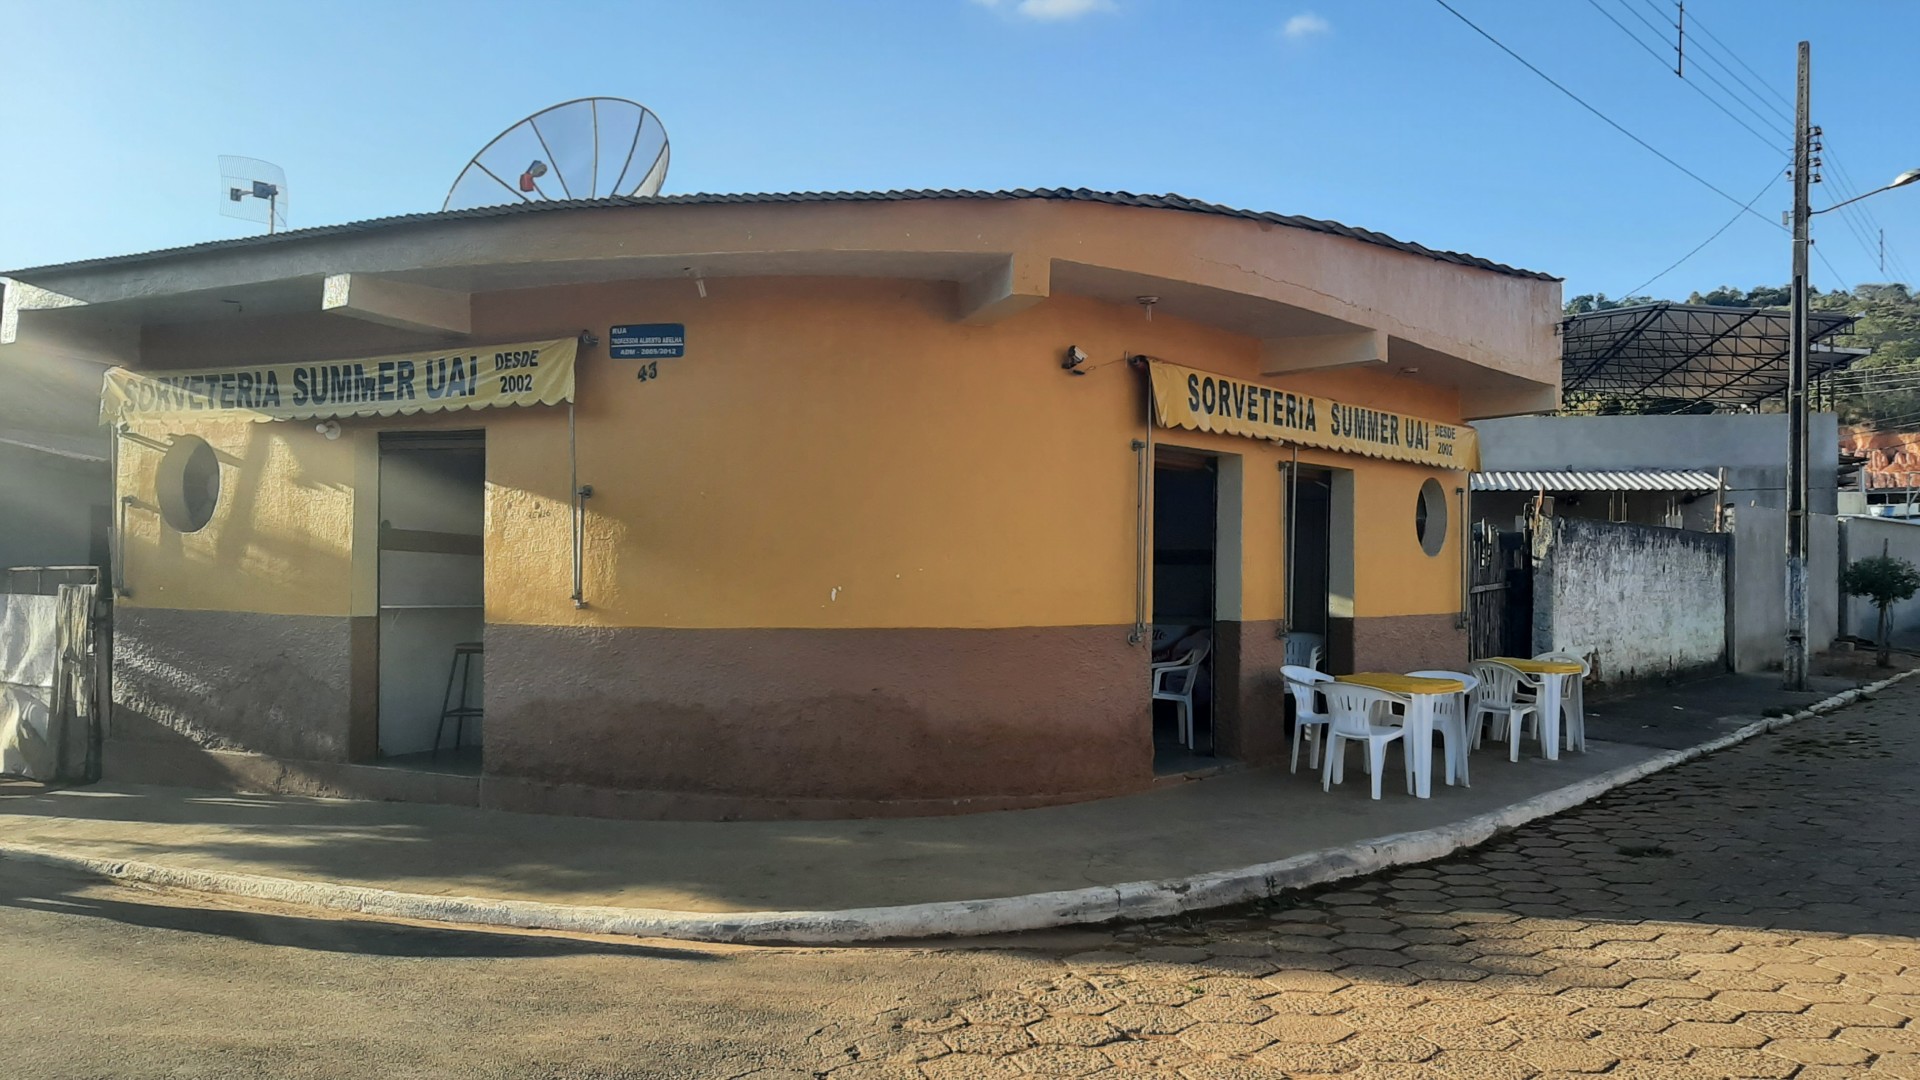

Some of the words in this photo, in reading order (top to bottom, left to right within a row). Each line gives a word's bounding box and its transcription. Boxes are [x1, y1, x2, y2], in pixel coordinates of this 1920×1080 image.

[495, 350, 539, 371] DESDE
[637, 361, 657, 382] 43
[122, 370, 281, 413] SORVETERIA
[292, 360, 415, 406] SUMMER
[425, 356, 478, 399] UAI
[500, 374, 533, 394] 2002
[1188, 373, 1317, 432] SORVETERIA
[1331, 403, 1399, 446] SUMMER
[1405, 418, 1429, 451] UAI
[1435, 424, 1456, 440] DESDE
[1437, 442, 1453, 456] 2002
